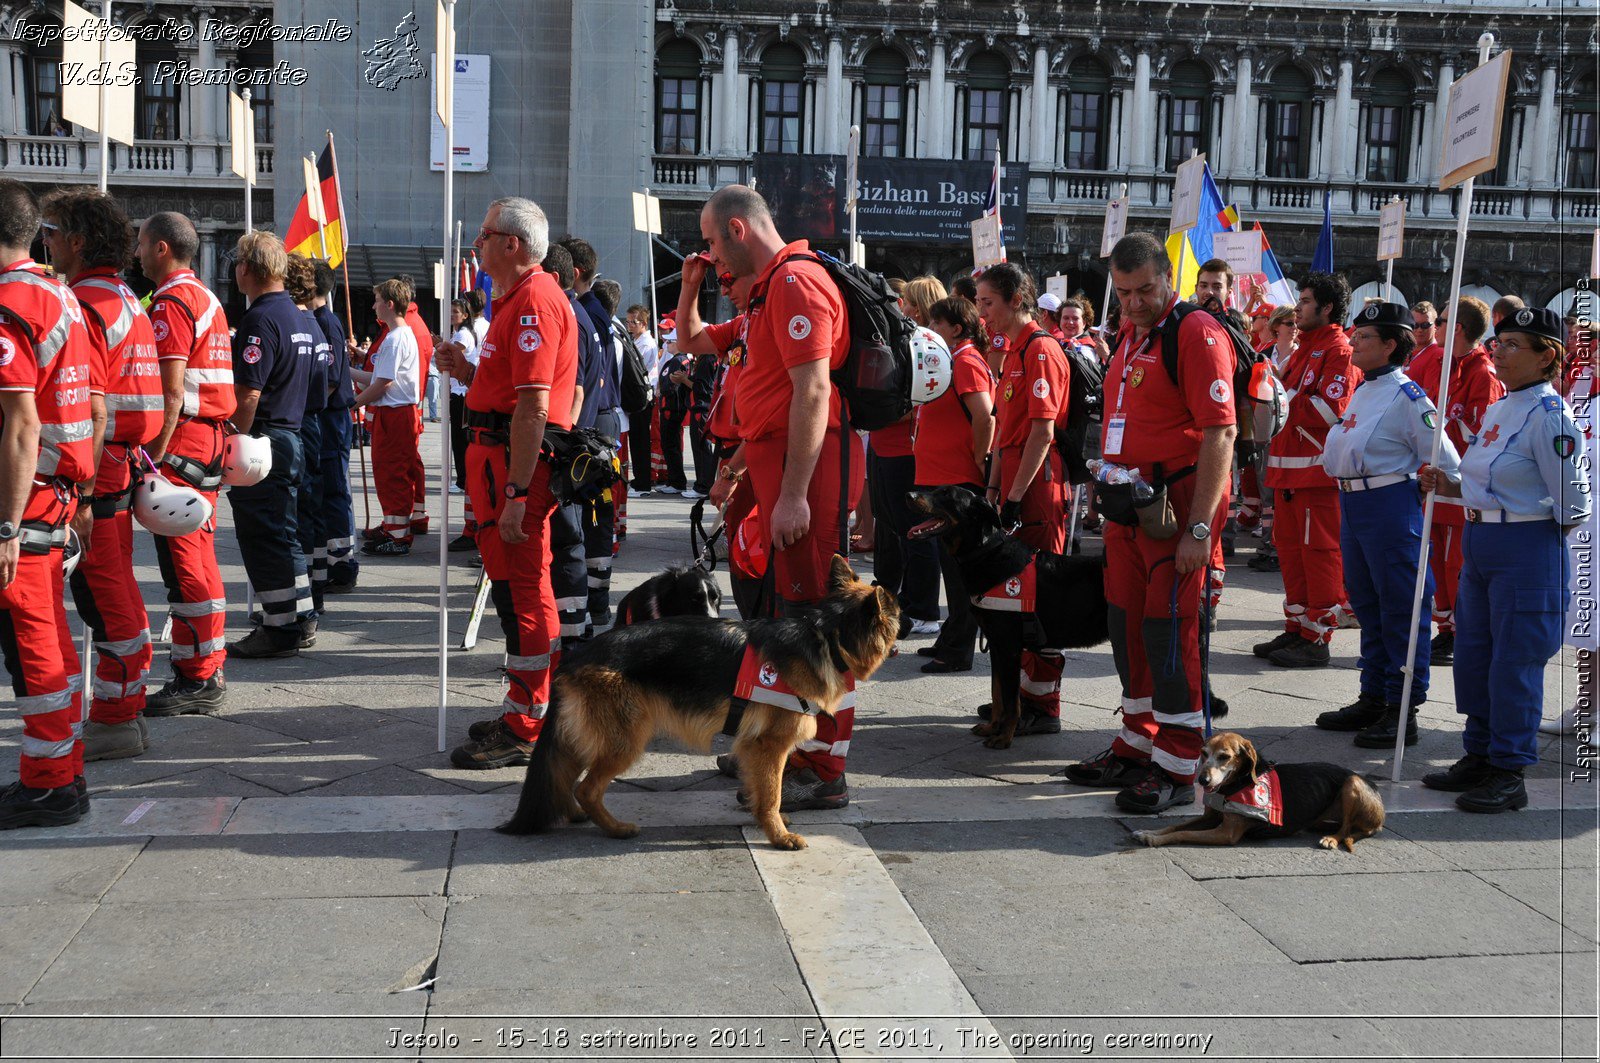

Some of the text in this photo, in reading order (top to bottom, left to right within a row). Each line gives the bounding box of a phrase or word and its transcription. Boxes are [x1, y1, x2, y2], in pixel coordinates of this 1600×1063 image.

[937, 181, 1020, 207] Bassri
[858, 204, 892, 214] caduta
[894, 205, 917, 216] delle
[919, 207, 962, 217] meteoriti
[944, 221, 962, 229] cura
[859, 229, 890, 237] Archeologico
